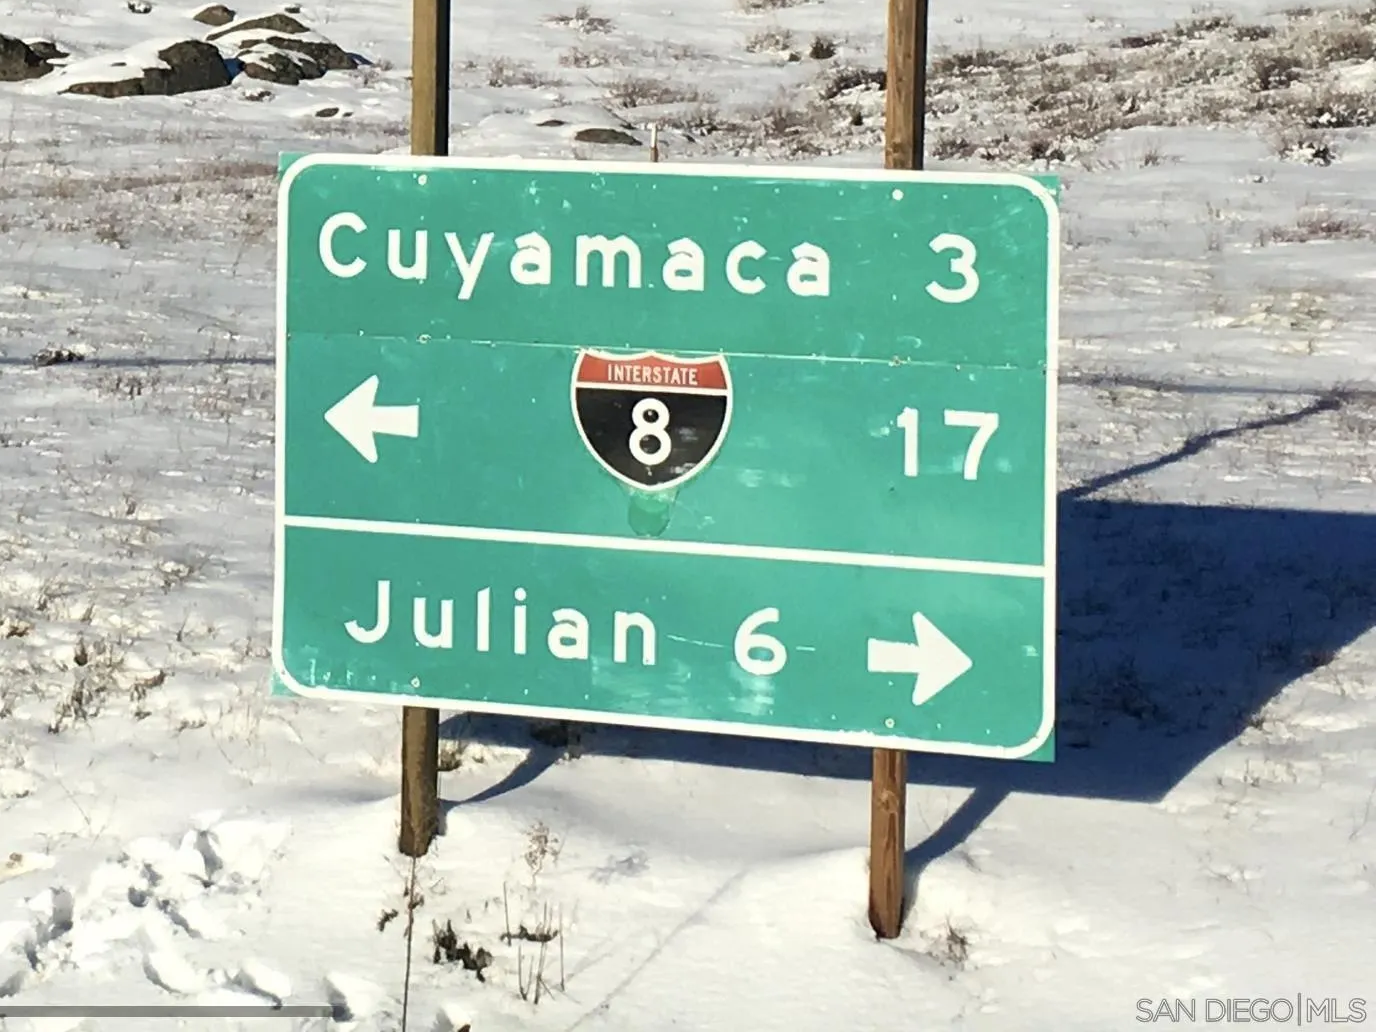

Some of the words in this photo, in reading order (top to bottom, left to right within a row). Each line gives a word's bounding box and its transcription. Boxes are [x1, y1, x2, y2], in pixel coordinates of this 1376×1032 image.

[319, 212, 830, 300] Cuyamaca
[925, 234, 979, 303] 3
[607, 364, 698, 386] INTERSTATE
[629, 397, 672, 466] 8
[895, 408, 999, 481] 17
[344, 580, 657, 666] Julian
[734, 608, 788, 676] 6
